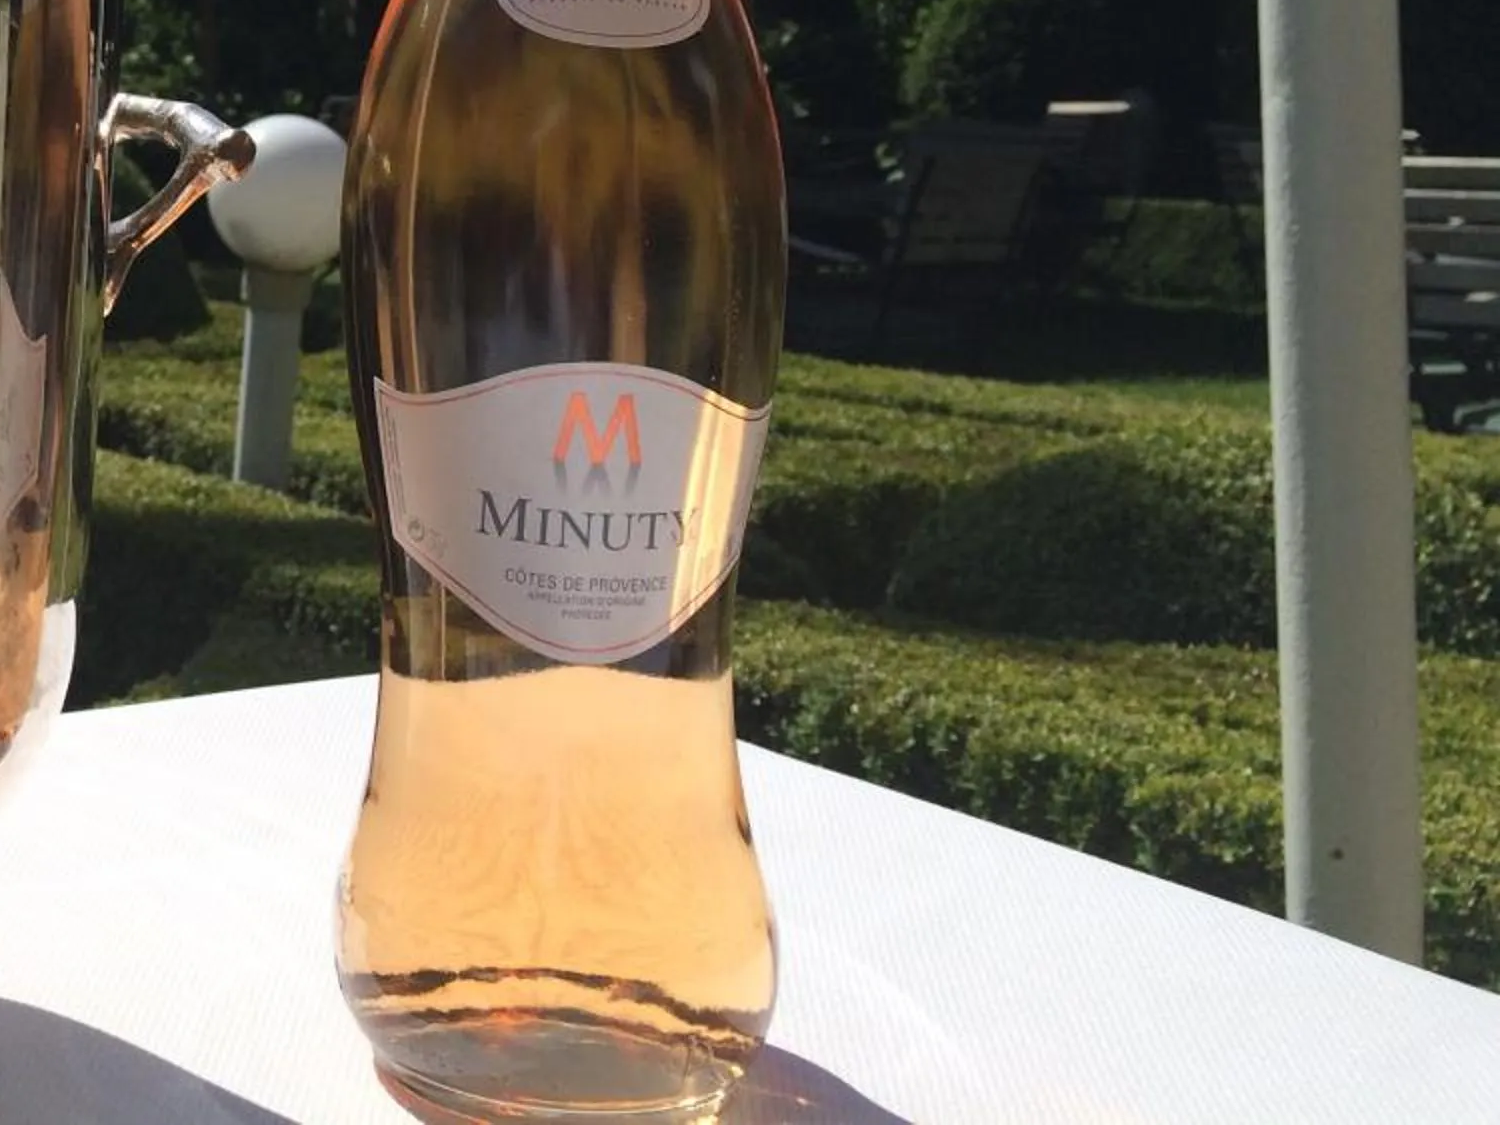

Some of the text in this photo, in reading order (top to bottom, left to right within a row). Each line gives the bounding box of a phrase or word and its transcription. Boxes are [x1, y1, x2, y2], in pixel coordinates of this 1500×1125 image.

[553, 391, 642, 467] M
[476, 488, 698, 551] MINUTY
[505, 567, 668, 593] CÔTES DE PROVENCE
